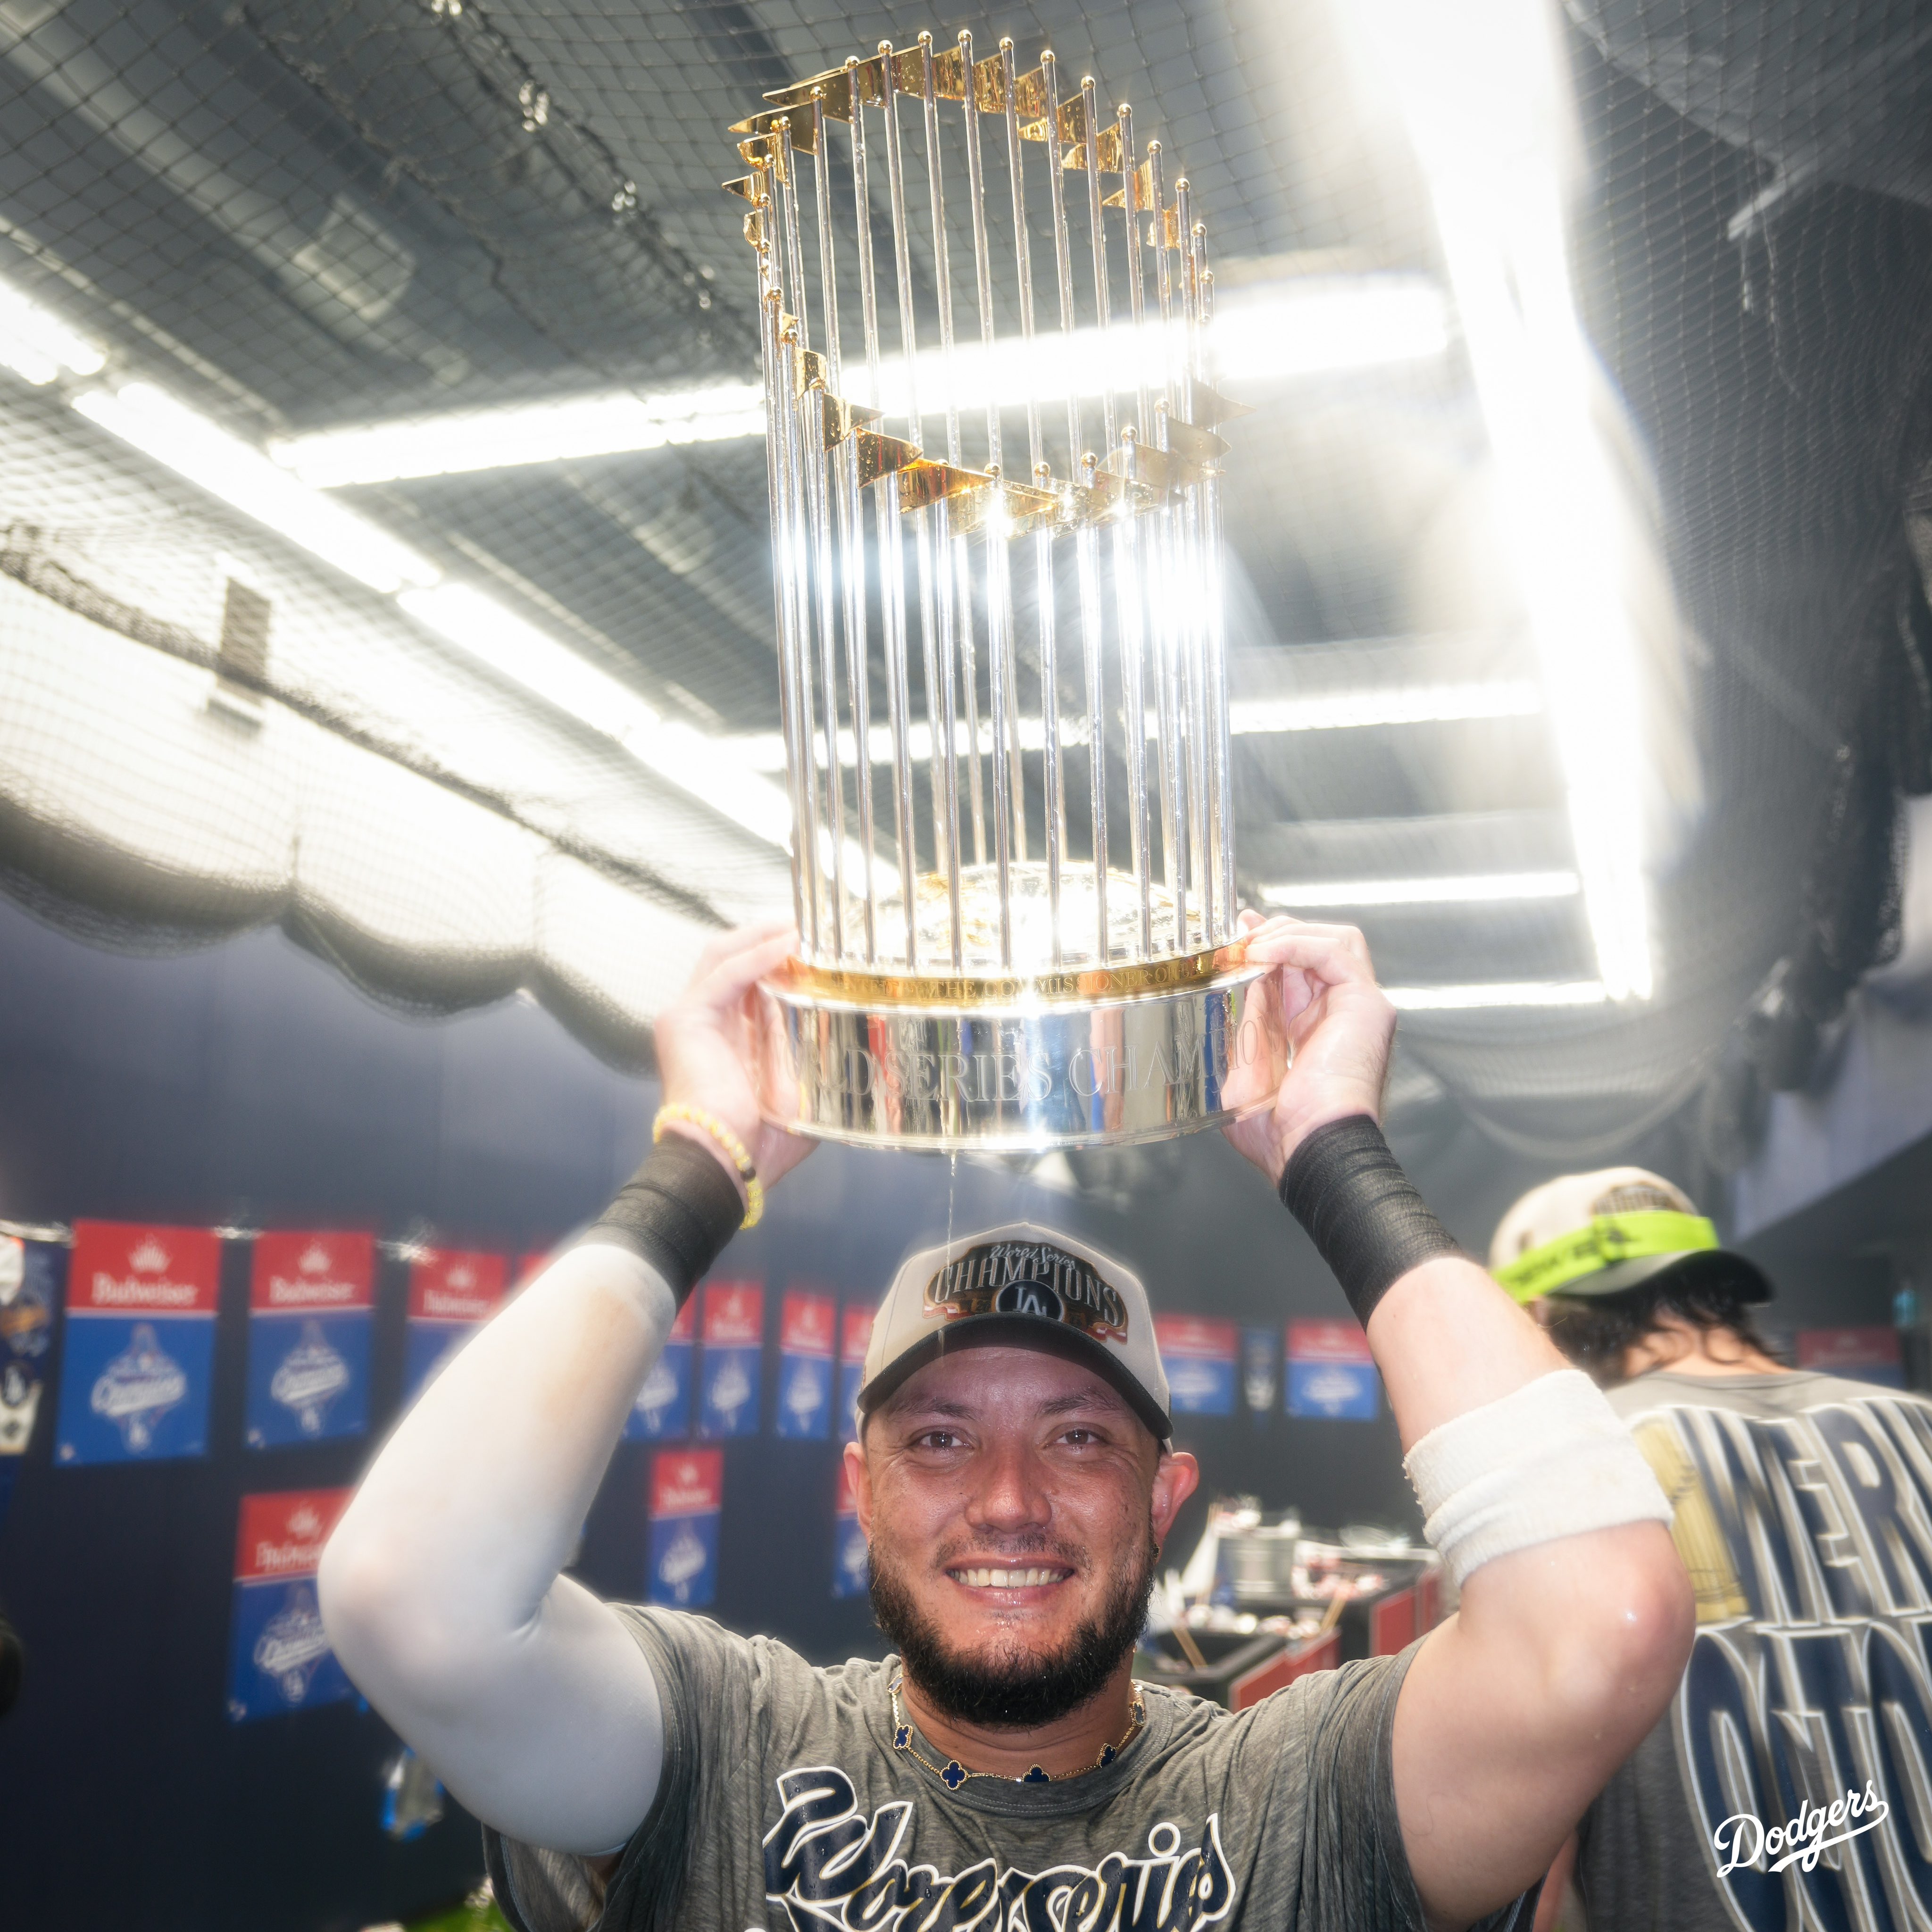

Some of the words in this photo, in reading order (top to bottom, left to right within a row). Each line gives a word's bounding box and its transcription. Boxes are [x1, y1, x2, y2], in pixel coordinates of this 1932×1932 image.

[932, 981, 975, 998] THE
[884, 1050, 1052, 1102] SERIES
[990, 1243, 1035, 1259] World
[1035, 1246, 1076, 1270] Series
[934, 1256, 1118, 1327] CHAMPIONS
